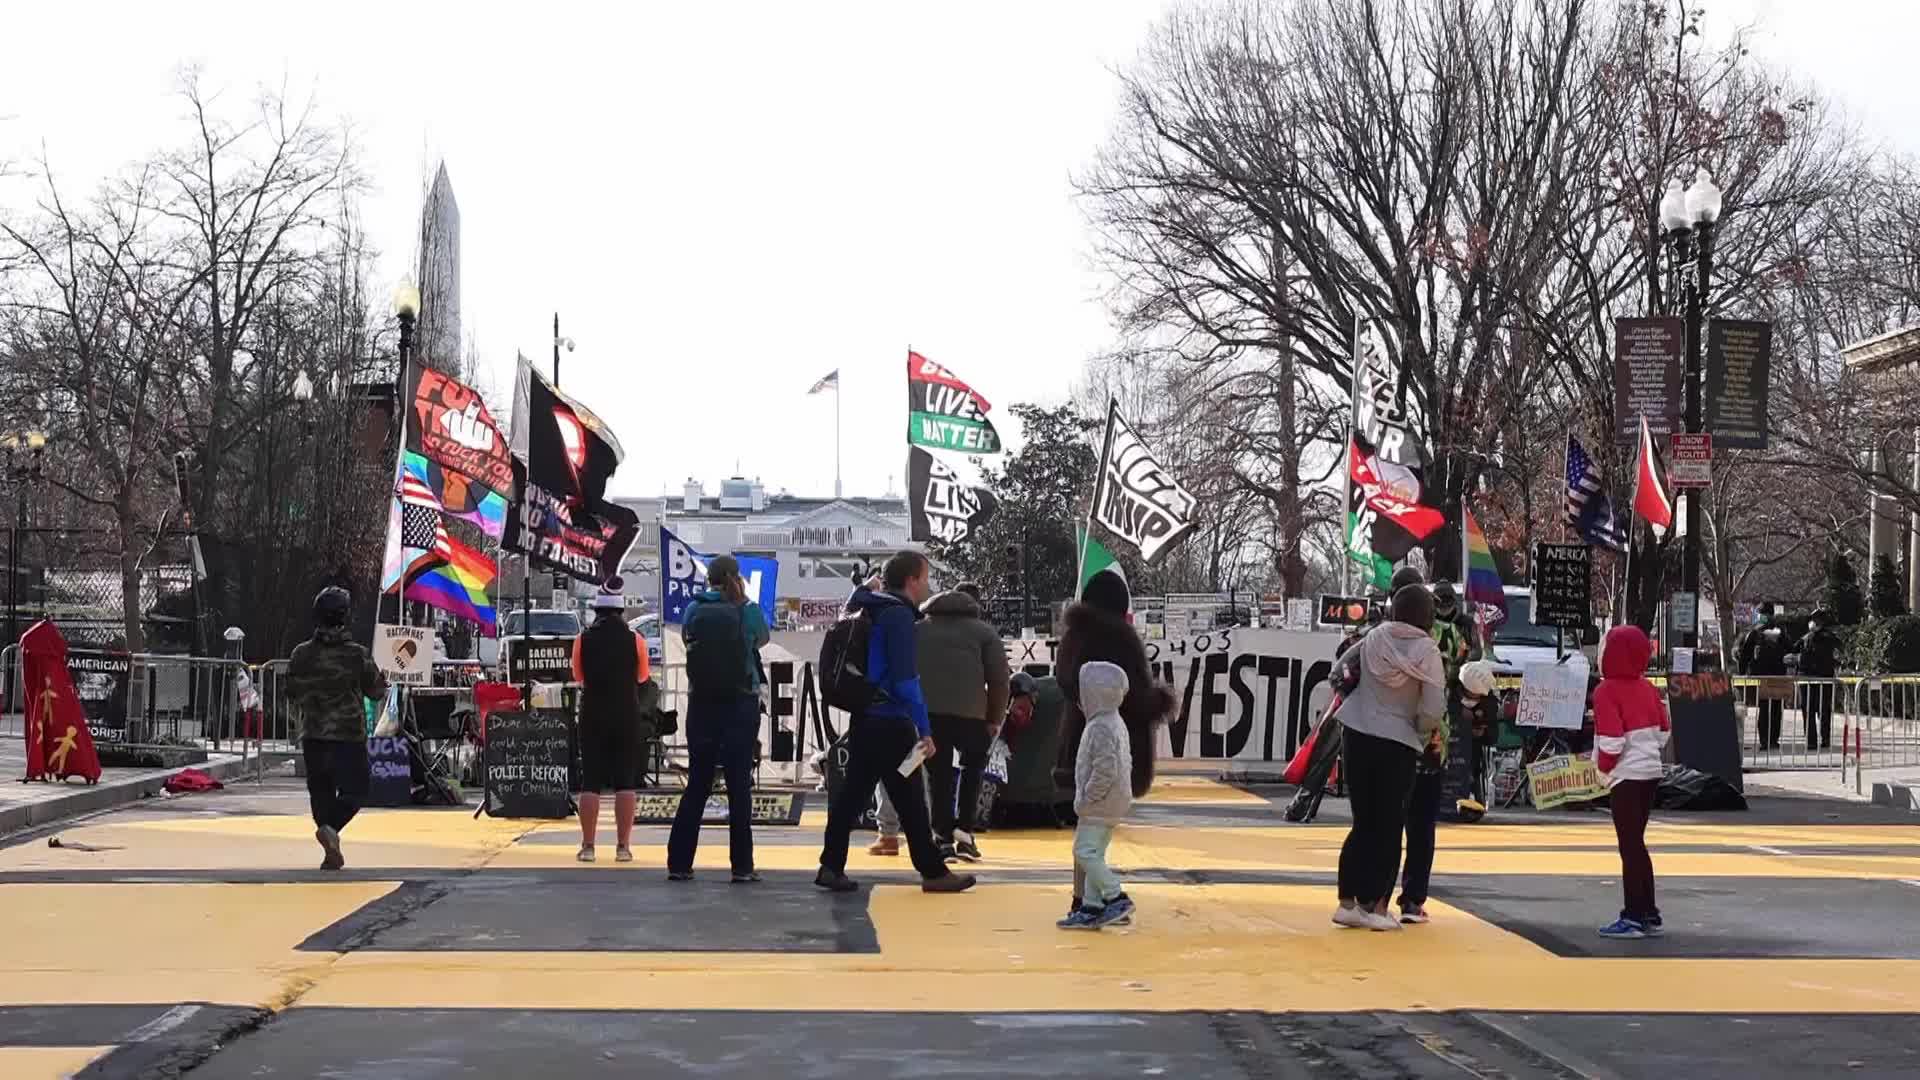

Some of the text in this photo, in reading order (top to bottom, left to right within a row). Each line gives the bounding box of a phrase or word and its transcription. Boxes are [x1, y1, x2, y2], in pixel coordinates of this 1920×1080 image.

[922, 418, 995, 449] MATTER
[483, 455, 514, 481] YOU
[1546, 547, 1587, 560] AMERICA
[801, 602, 840, 618] RESIST
[528, 647, 565, 659] SACRED
[67, 657, 128, 672] AMERICAN
[88, 726, 125, 743] ORIST
[368, 737, 409, 756] UCK
[521, 739, 543, 753] you
[488, 765, 568, 783] POLICE REFORM
